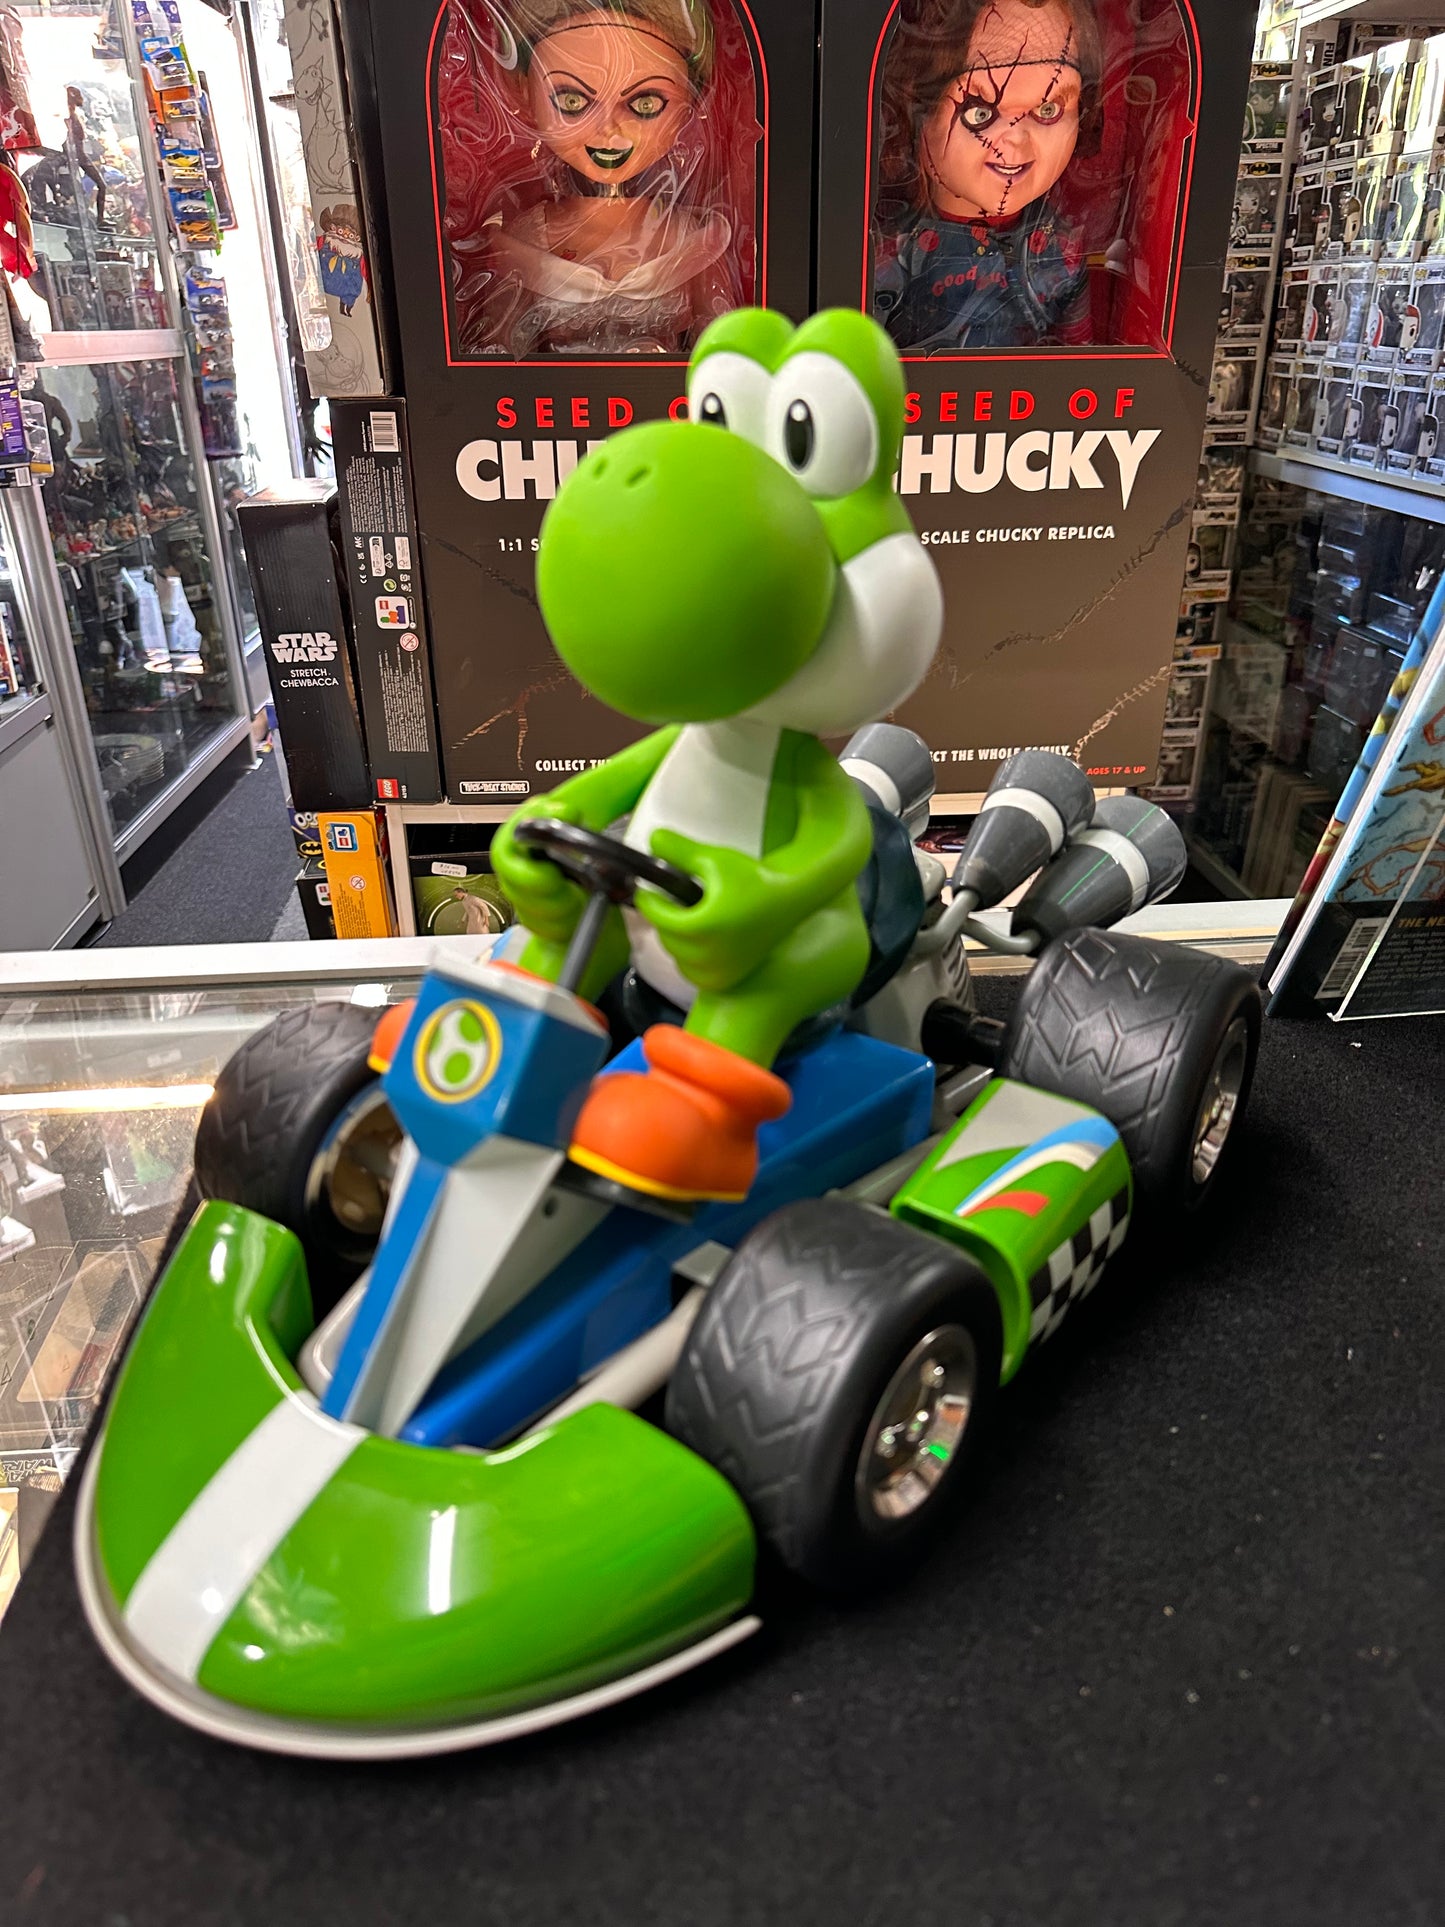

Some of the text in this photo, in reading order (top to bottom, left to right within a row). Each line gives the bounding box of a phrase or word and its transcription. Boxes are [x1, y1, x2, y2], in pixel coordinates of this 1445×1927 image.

[496, 397, 634, 428] SEED
[904, 388, 1135, 424] SEED OF
[893, 430, 1162, 511] HUCKY
[921, 526, 1115, 545] SCALE CHUCKY REPLICA
[499, 538, 544, 552] 1:1 S
[270, 632, 337, 649] STAR
[272, 646, 338, 663] WARS
[290, 668, 327, 678] STRETCH
[280, 678, 339, 688] CHEWBACCA
[951, 749, 974, 761] THE
[535, 759, 586, 772] COLLECT
[1086, 767, 1110, 775] AGES
[1112, 766, 1122, 774] 17
[1133, 766, 1146, 774] UP
[382, 779, 393, 798] LEGO
